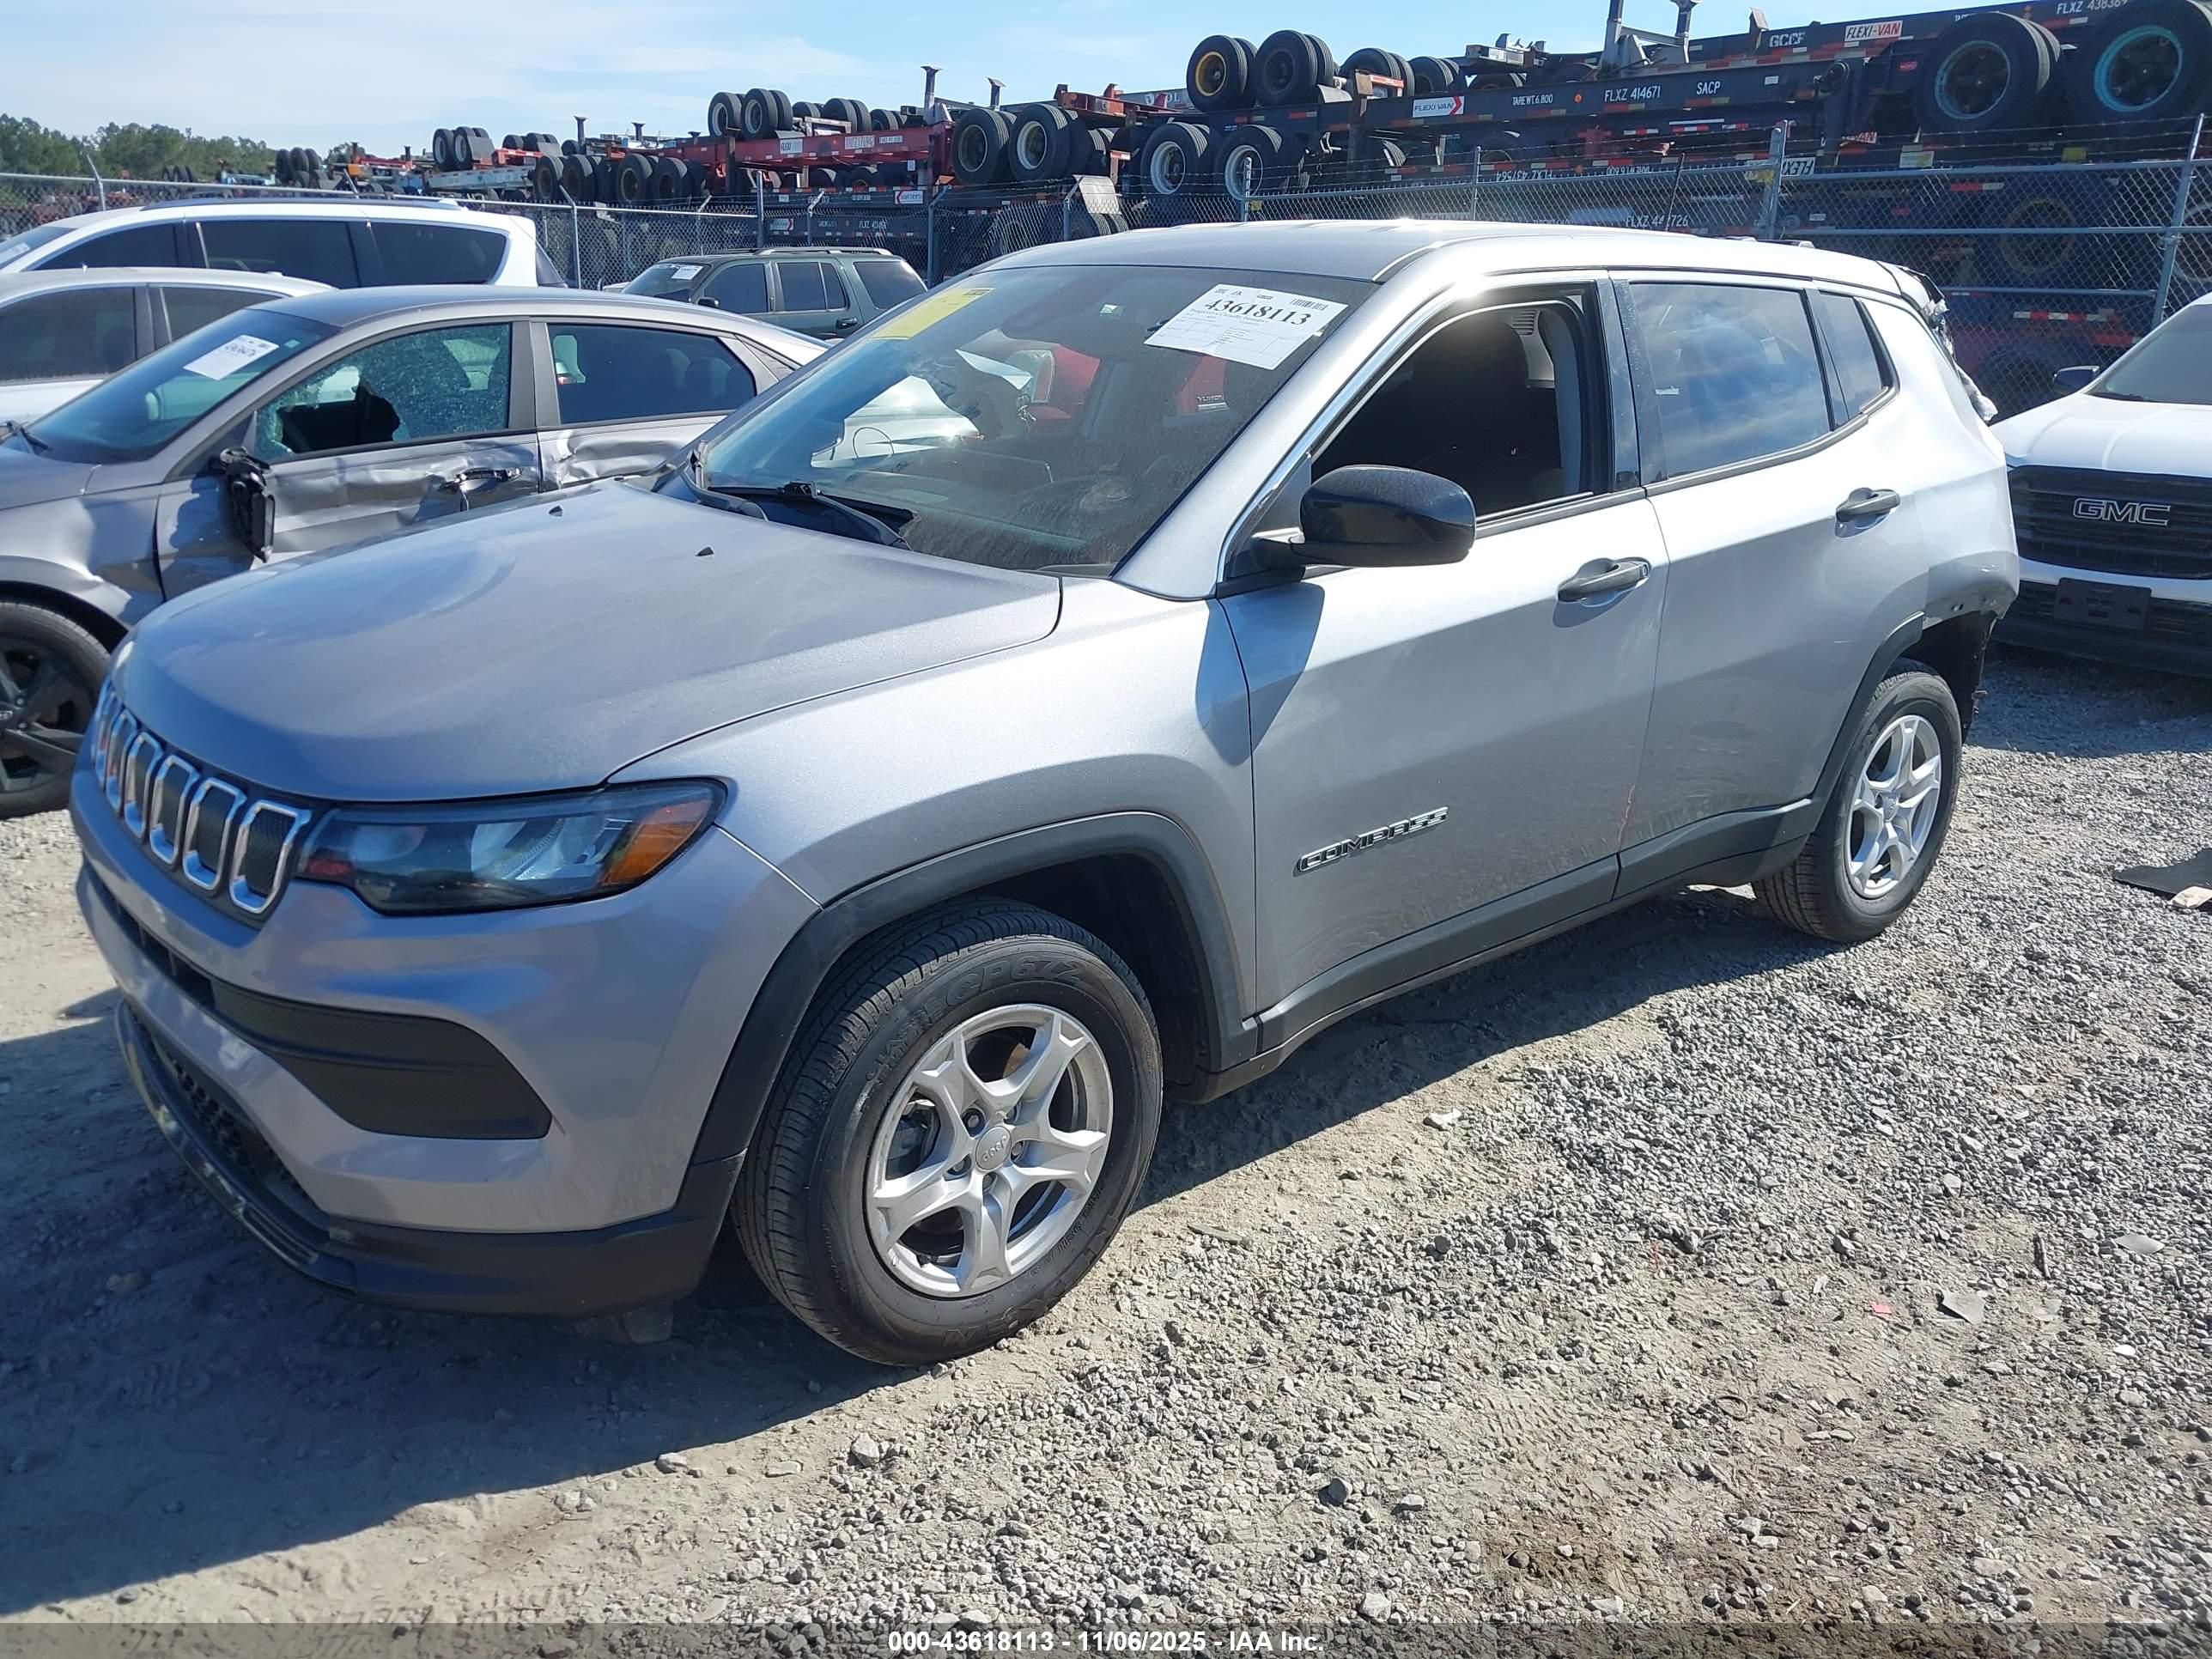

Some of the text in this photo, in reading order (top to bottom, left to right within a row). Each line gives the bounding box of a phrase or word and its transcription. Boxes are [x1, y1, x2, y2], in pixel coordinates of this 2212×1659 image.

[2057, 1, 2084, 15] FLXZ
[1846, 23, 1900, 40] FLEXI-VAN
[1604, 88, 1628, 102] FLXZ
[1630, 85, 1662, 100] 414671
[1696, 81, 1721, 95] SACP
[1626, 215, 1650, 228] FLXZ
[1204, 299, 1312, 325] 43618113
[2073, 497, 2171, 526] GMC
[1298, 806, 1449, 872] COMPASS
